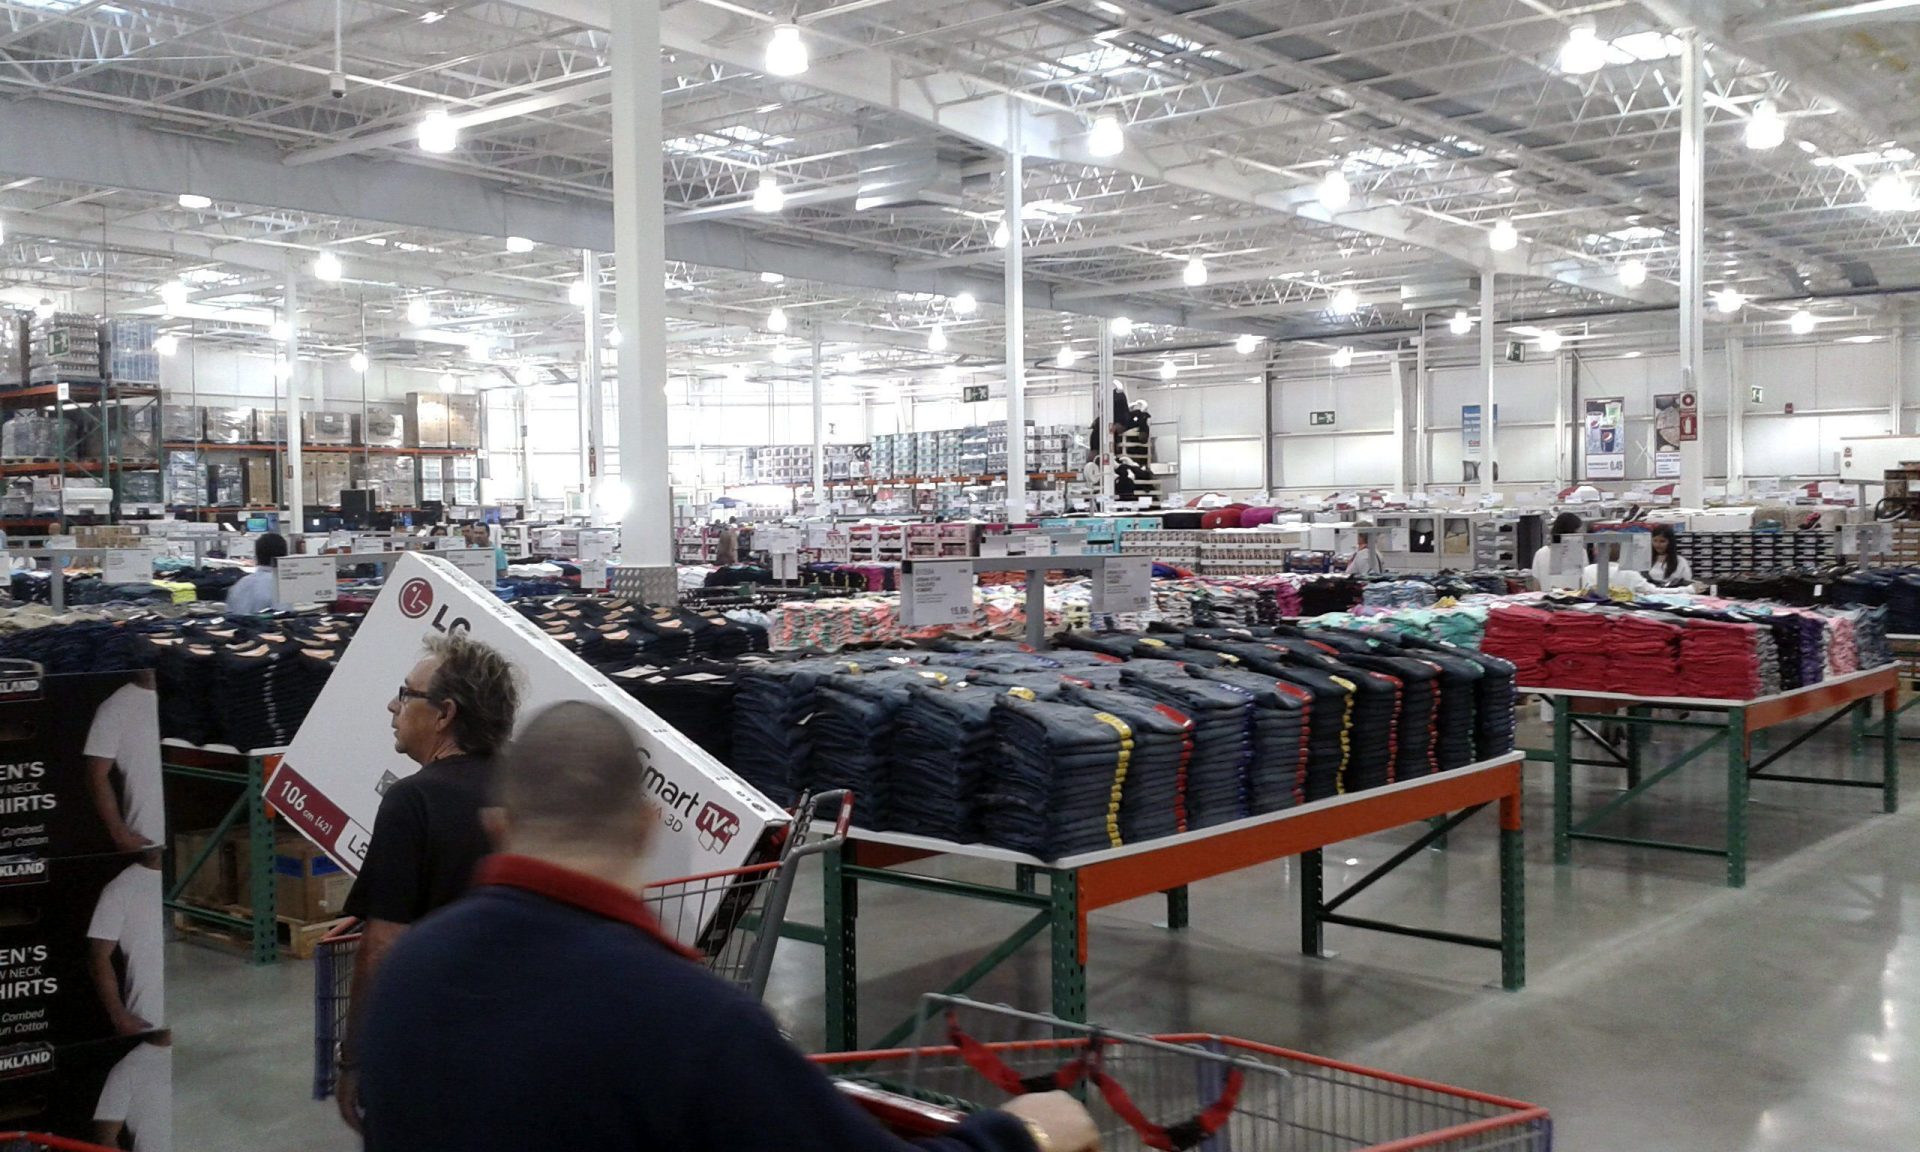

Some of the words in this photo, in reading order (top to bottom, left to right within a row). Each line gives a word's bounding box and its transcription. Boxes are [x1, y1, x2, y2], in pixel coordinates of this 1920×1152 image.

[281, 780, 308, 811] 106
[664, 813, 684, 833] 3D
[9, 965, 43, 979] NECK
[2, 1008, 45, 1023] Combed
[14, 1020, 49, 1034] Cotton
